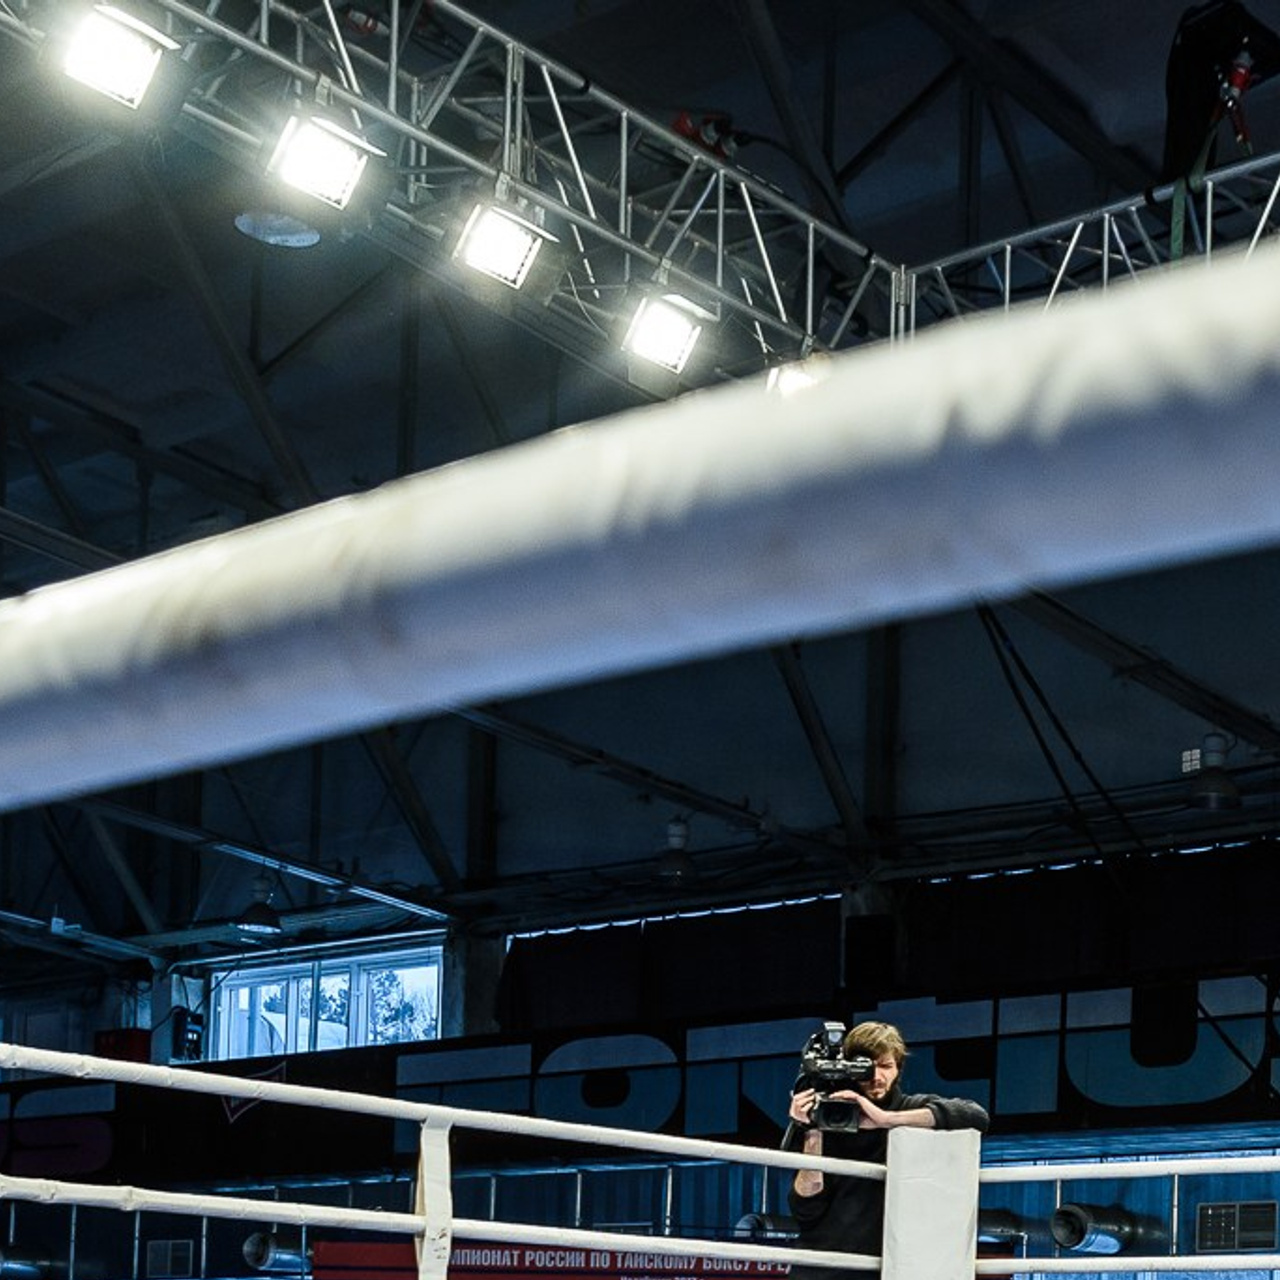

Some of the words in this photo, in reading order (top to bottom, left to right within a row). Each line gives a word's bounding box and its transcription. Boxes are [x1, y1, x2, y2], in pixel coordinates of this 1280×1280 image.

[451, 1248, 520, 1266] МПИОНАТ
[525, 1249, 586, 1268] РОССИИ
[590, 1251, 611, 1269] ПО
